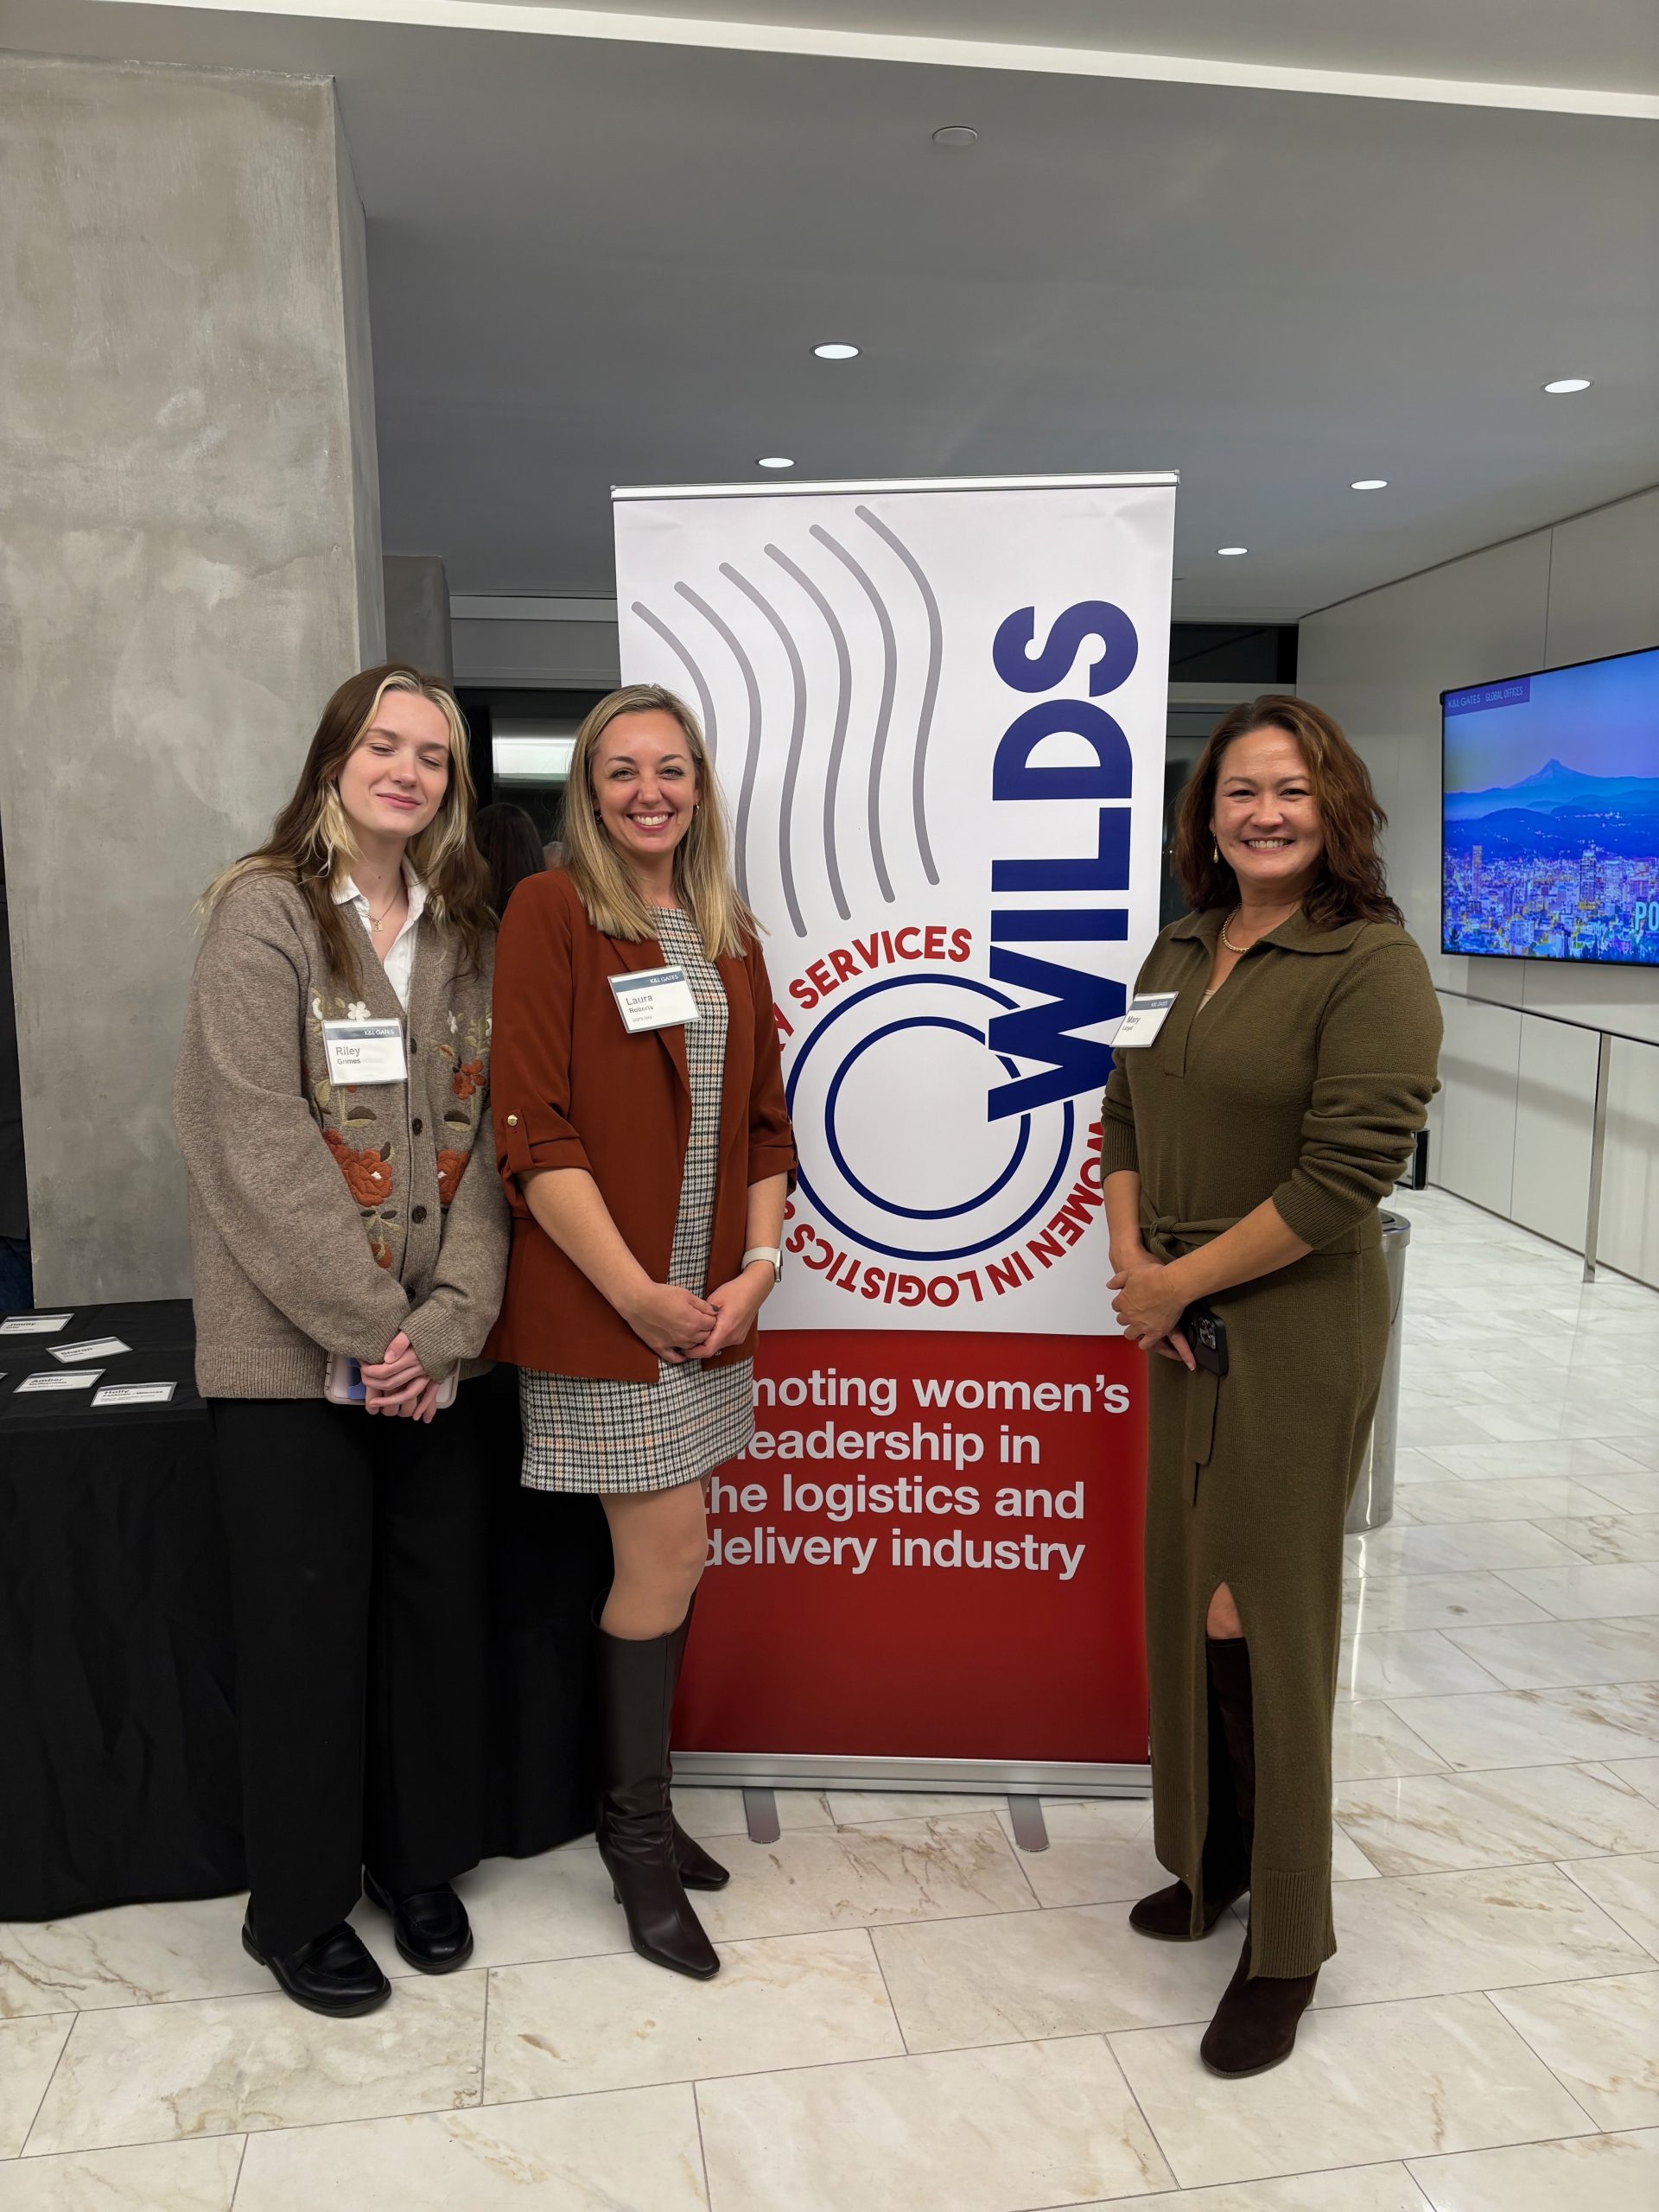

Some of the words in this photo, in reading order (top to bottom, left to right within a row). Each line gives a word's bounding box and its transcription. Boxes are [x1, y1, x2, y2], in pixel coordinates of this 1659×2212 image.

[1460, 694, 1481, 706] GATES
[1485, 690, 1503, 702] GLOBAL
[1503, 686, 1523, 699] OFFICES
[988, 601, 1138, 1122] WILDS
[661, 974, 679, 983] GATES
[788, 925, 972, 1009] SERVICES
[626, 995, 653, 1006] Laura
[629, 1005, 654, 1014] Roberts
[1126, 1016, 1141, 1025] Mary
[335, 1046, 360, 1057] Riley
[785, 1223, 984, 1307] LOGISTICS
[985, 1251, 1034, 1295] IN
[737, 1421, 984, 1470] eadership
[1000, 1425, 1039, 1464] in
[783, 1474, 980, 1522] logistics
[995, 1481, 1084, 1520] and
[704, 1527, 877, 1574] delivery
[892, 1528, 1085, 1580] industry
